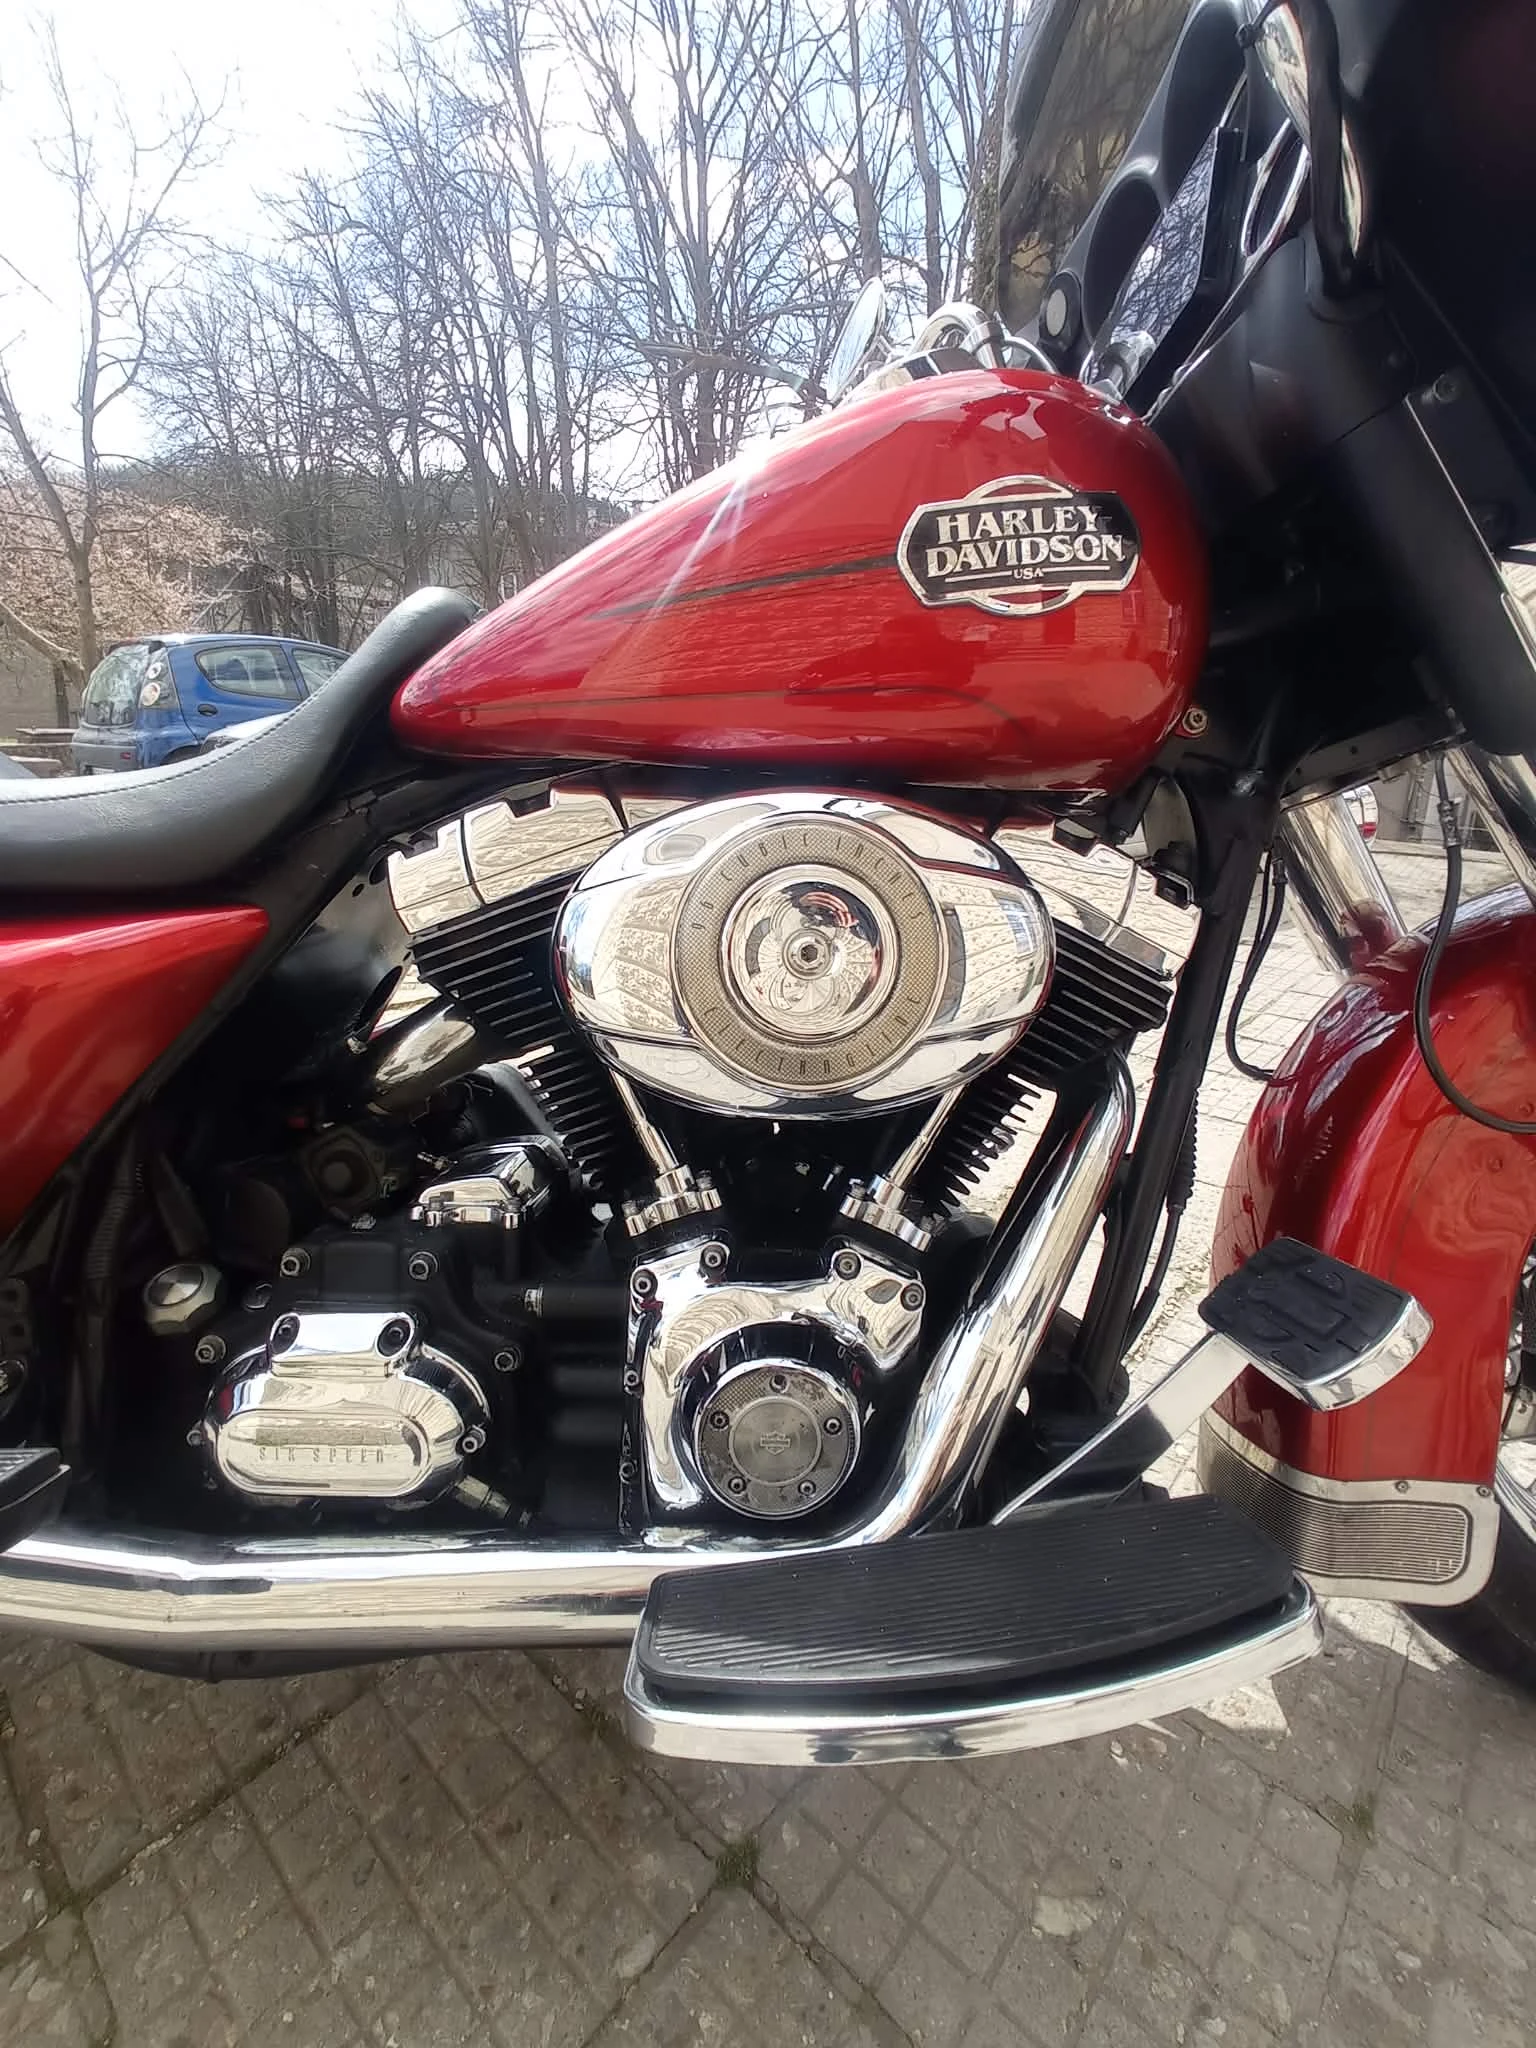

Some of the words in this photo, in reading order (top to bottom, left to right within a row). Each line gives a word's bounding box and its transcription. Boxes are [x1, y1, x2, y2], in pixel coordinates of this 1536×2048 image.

[936, 505, 1101, 545] HARLEY
[926, 534, 1126, 578] DAVIDSON
[1013, 567, 1044, 580] USA
[720, 832, 808, 881] CUBIC
[835, 834, 923, 920] INCHES
[259, 1446, 296, 1462] SIX
[312, 1446, 384, 1464] SPEED
